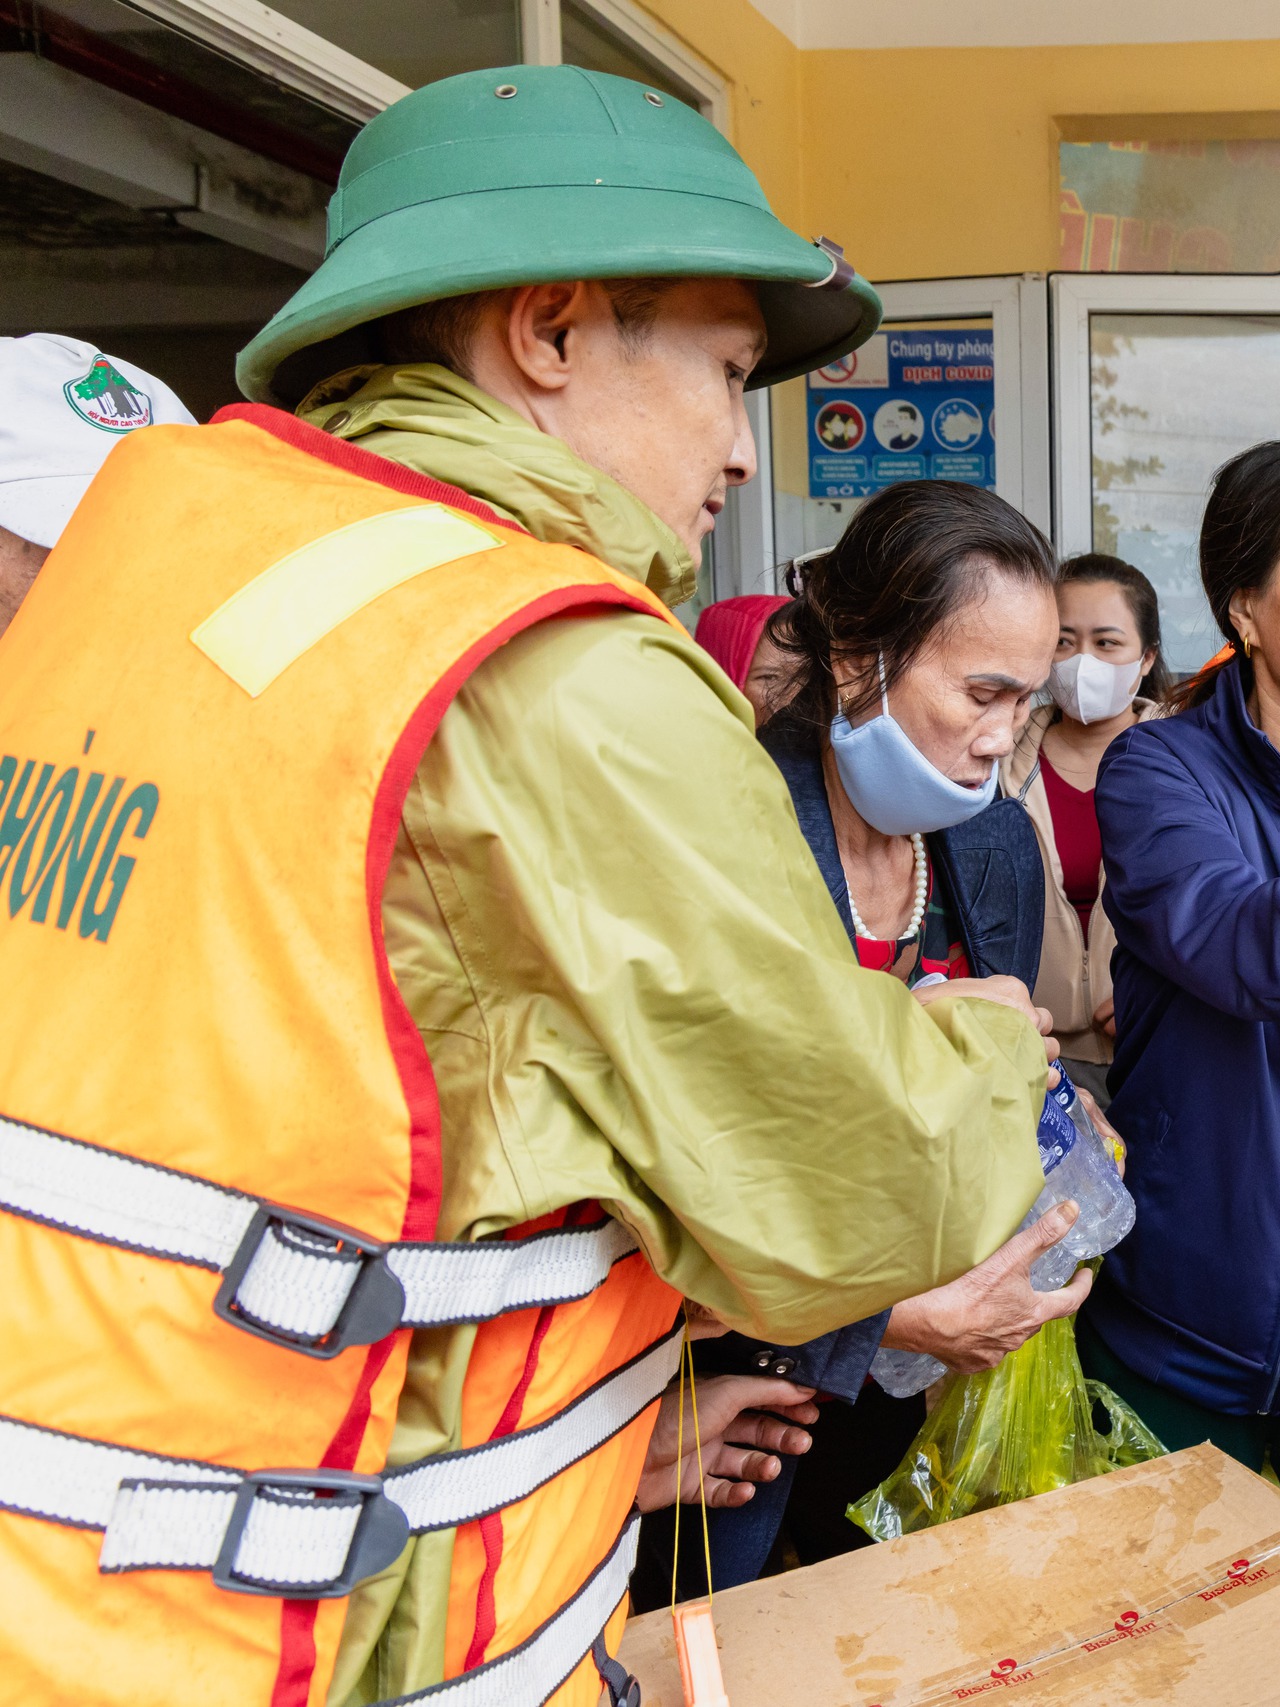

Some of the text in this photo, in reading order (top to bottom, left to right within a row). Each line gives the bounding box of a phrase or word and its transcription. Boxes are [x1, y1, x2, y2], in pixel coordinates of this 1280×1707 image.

[890, 340, 932, 361] Chung
[935, 341, 954, 360] tay
[945, 365, 993, 381] COVID
